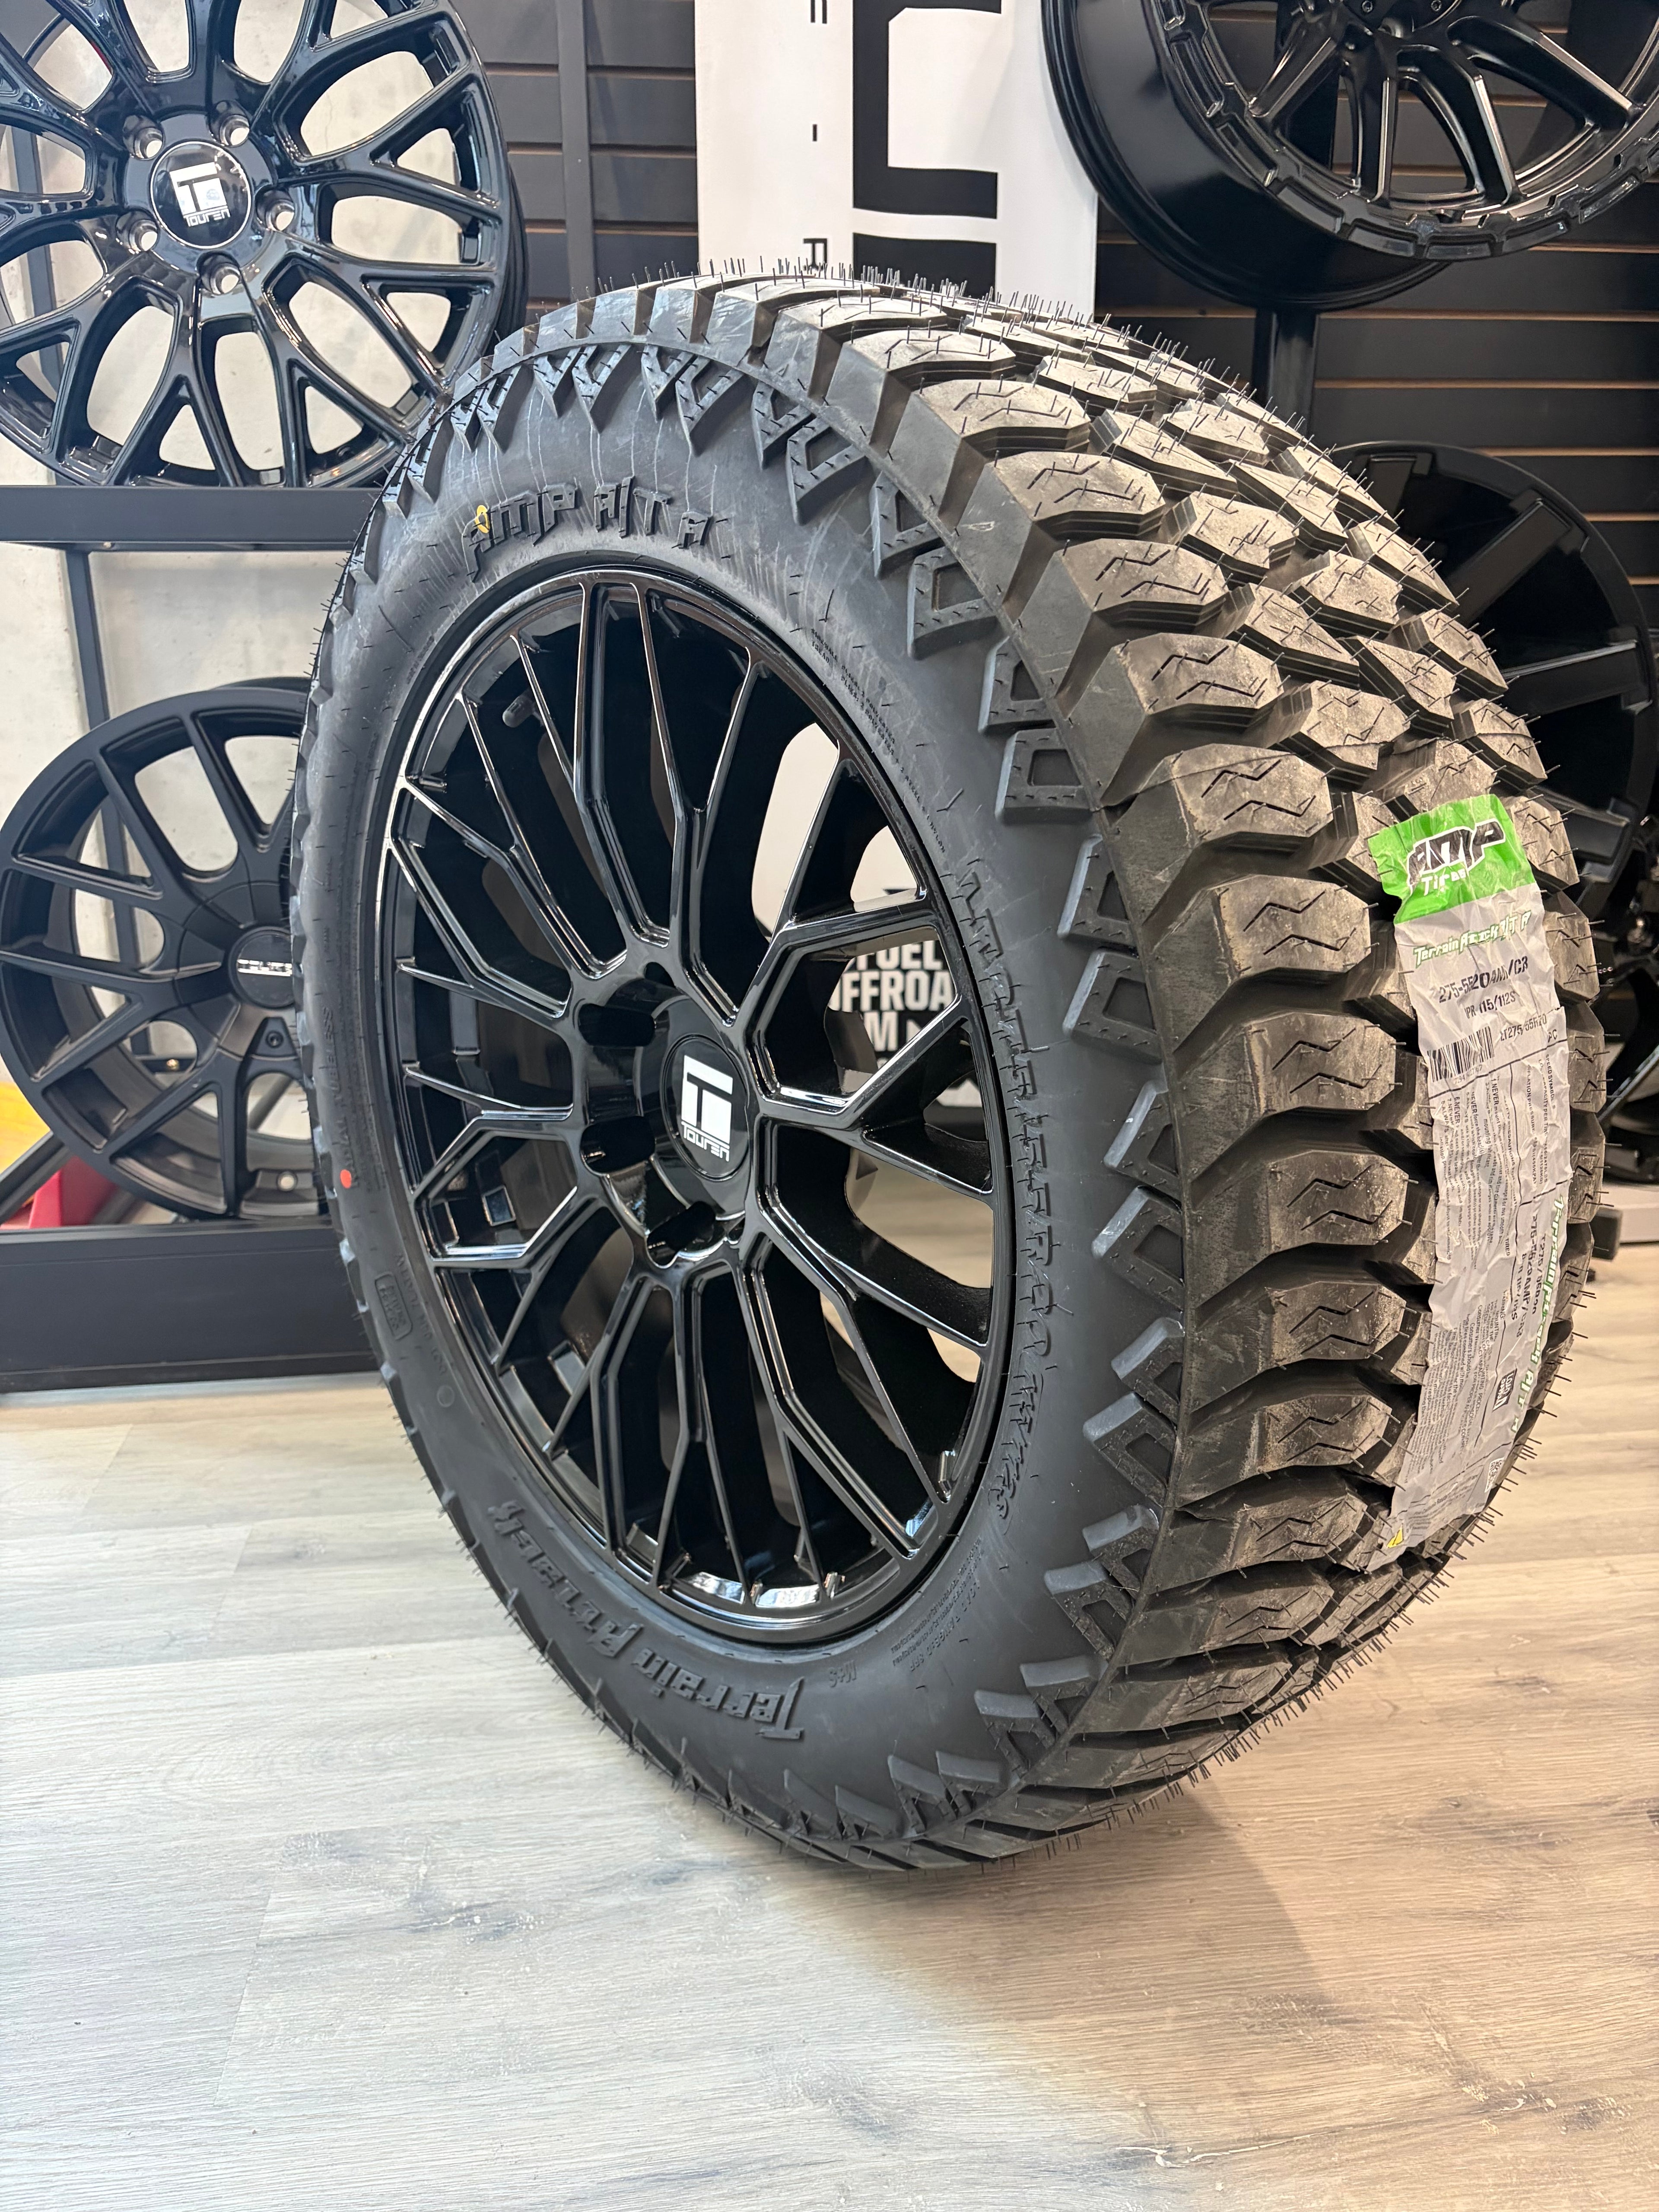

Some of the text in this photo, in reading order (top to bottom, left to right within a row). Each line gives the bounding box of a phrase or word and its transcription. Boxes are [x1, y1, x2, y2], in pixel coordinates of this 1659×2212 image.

[1413, 937, 1459, 969] Terrain
[680, 1121, 730, 1162] TOUREN
[632, 1647, 806, 1740] Terrain
